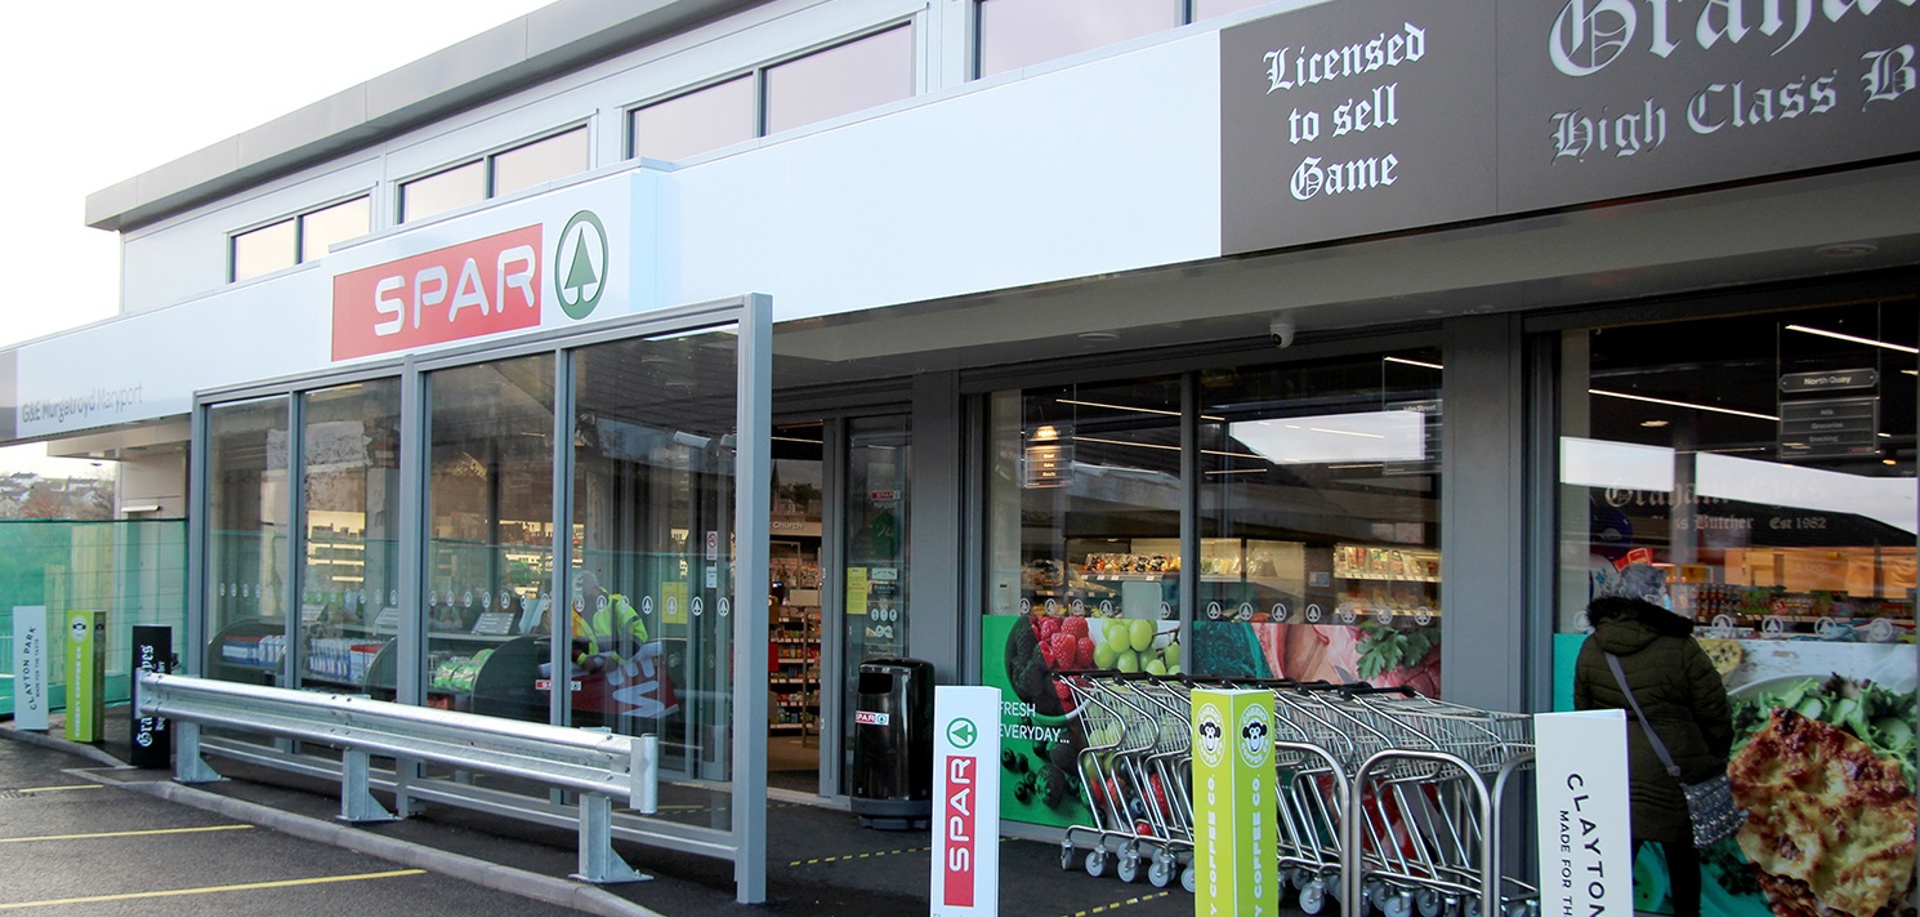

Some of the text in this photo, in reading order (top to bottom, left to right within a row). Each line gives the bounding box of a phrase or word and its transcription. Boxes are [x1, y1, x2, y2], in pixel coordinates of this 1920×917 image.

[1262, 22, 1425, 95] Licensed
[1549, 0, 1920, 77] Grah
[1288, 82, 1399, 144] to sell
[1550, 97, 1667, 166] High
[1686, 68, 1838, 135] Class
[1290, 153, 1399, 201] Game
[374, 244, 536, 336] SPAR
[1804, 375, 1852, 386] North Quay
[1694, 513, 1754, 532] Butcher
[1769, 516, 1793, 530] Est
[1796, 516, 1827, 530] 1982
[23, 626, 37, 710] CLAYTON PARK
[856, 713, 876, 722] PAR
[949, 757, 972, 872] SPAR
[1207, 774, 1216, 807] CO.
[1252, 774, 1261, 808] CO.
[1207, 811, 1218, 899] COFFEE
[1252, 811, 1262, 899] COFFEE
[1559, 810, 1571, 853] MADE
[1567, 773, 1605, 917] CLAYTON
[1561, 859, 1572, 888] FOR
